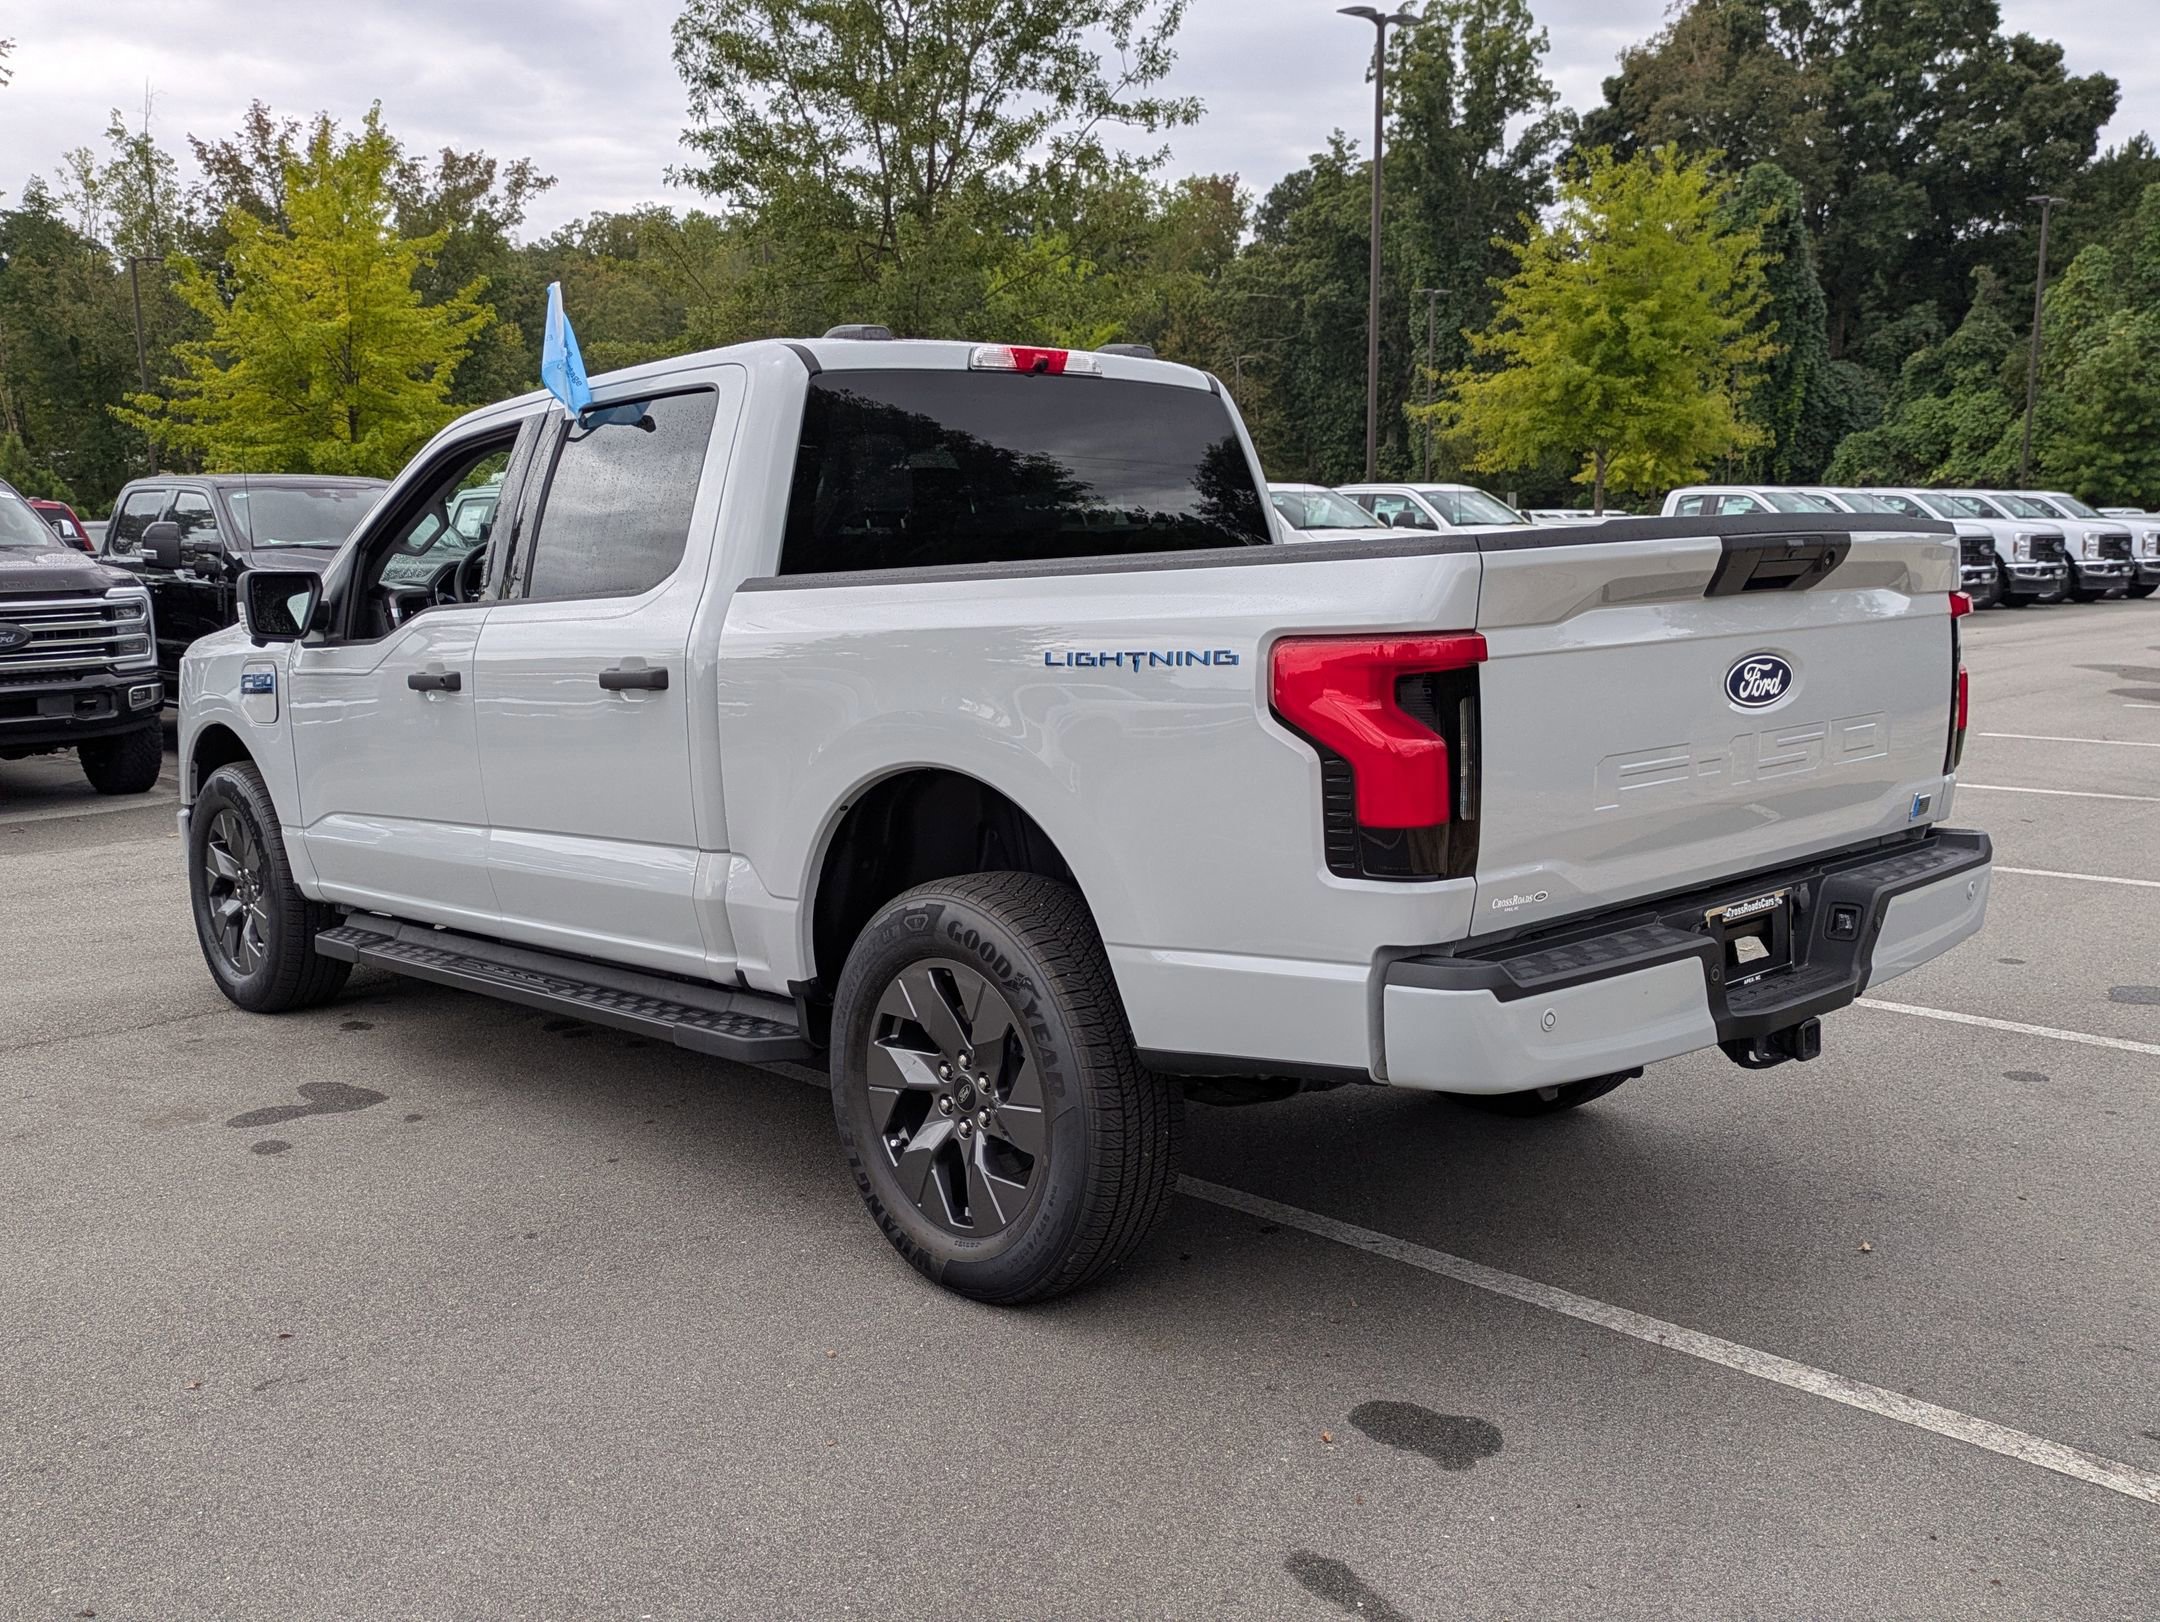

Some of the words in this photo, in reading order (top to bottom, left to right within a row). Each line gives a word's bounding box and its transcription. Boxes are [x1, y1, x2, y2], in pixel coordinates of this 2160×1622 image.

[1044, 650, 1240, 673] LIGHTNING
[1739, 662, 1783, 699] Ford
[1594, 710, 1890, 811] F-150
